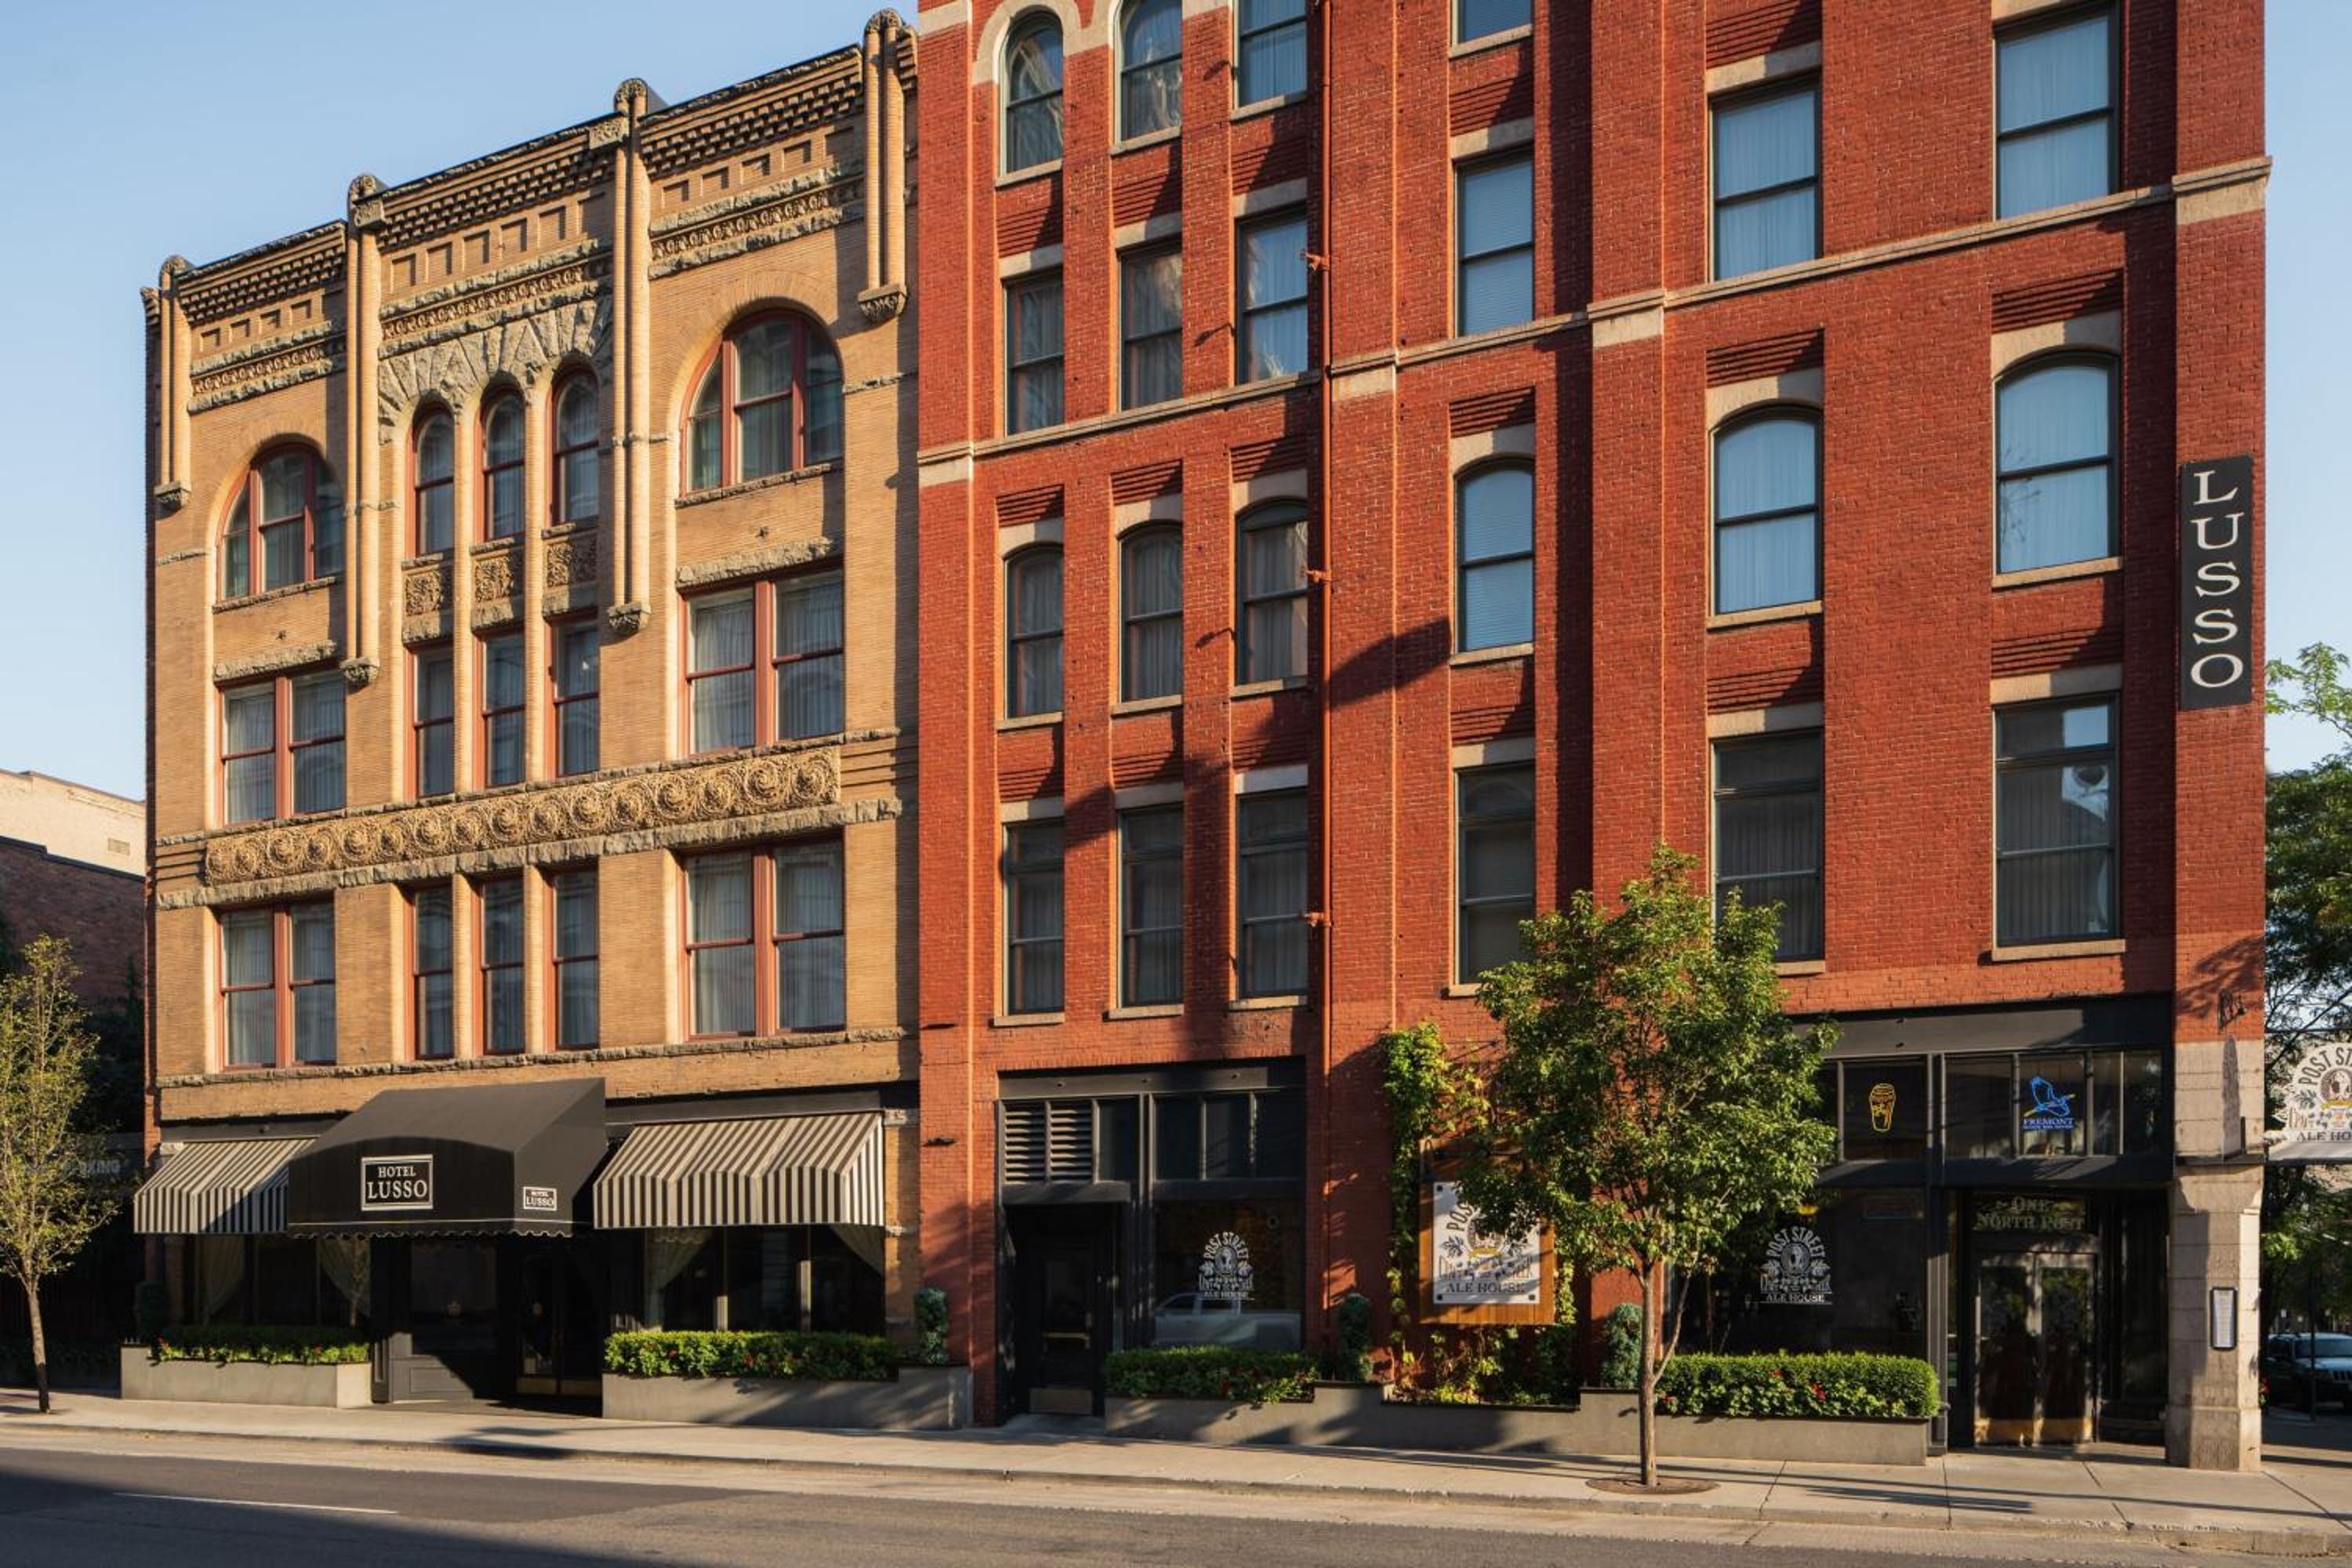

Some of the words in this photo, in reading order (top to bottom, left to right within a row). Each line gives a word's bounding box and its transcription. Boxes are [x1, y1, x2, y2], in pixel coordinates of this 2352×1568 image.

[2190, 469, 2245, 688] LUSSO
[2298, 1050, 2332, 1086] POST
[2336, 1047, 2352, 1066] ST
[2024, 1117, 2075, 1126] FREMONT
[2297, 1131, 2327, 1141] ALE
[378, 1166, 416, 1178] HOTEL
[367, 1180, 428, 1200] LUSSO
[526, 1196, 555, 1207] LUSSO
[2009, 1196, 2051, 1212] ONE
[1446, 1201, 1474, 1232] POS
[1973, 1213, 2034, 1229] NORTH
[2040, 1215, 2084, 1230] POST
[1203, 1233, 1222, 1260] POST
[1222, 1232, 1249, 1259] STREET
[1766, 1229, 1791, 1257] POST
[1791, 1225, 1826, 1258] STREET
[1446, 1281, 1474, 1293] ALE
[1478, 1281, 1526, 1293] HOUSE
[1766, 1294, 1787, 1302] ALE
[1789, 1294, 1825, 1303] HOUSE
